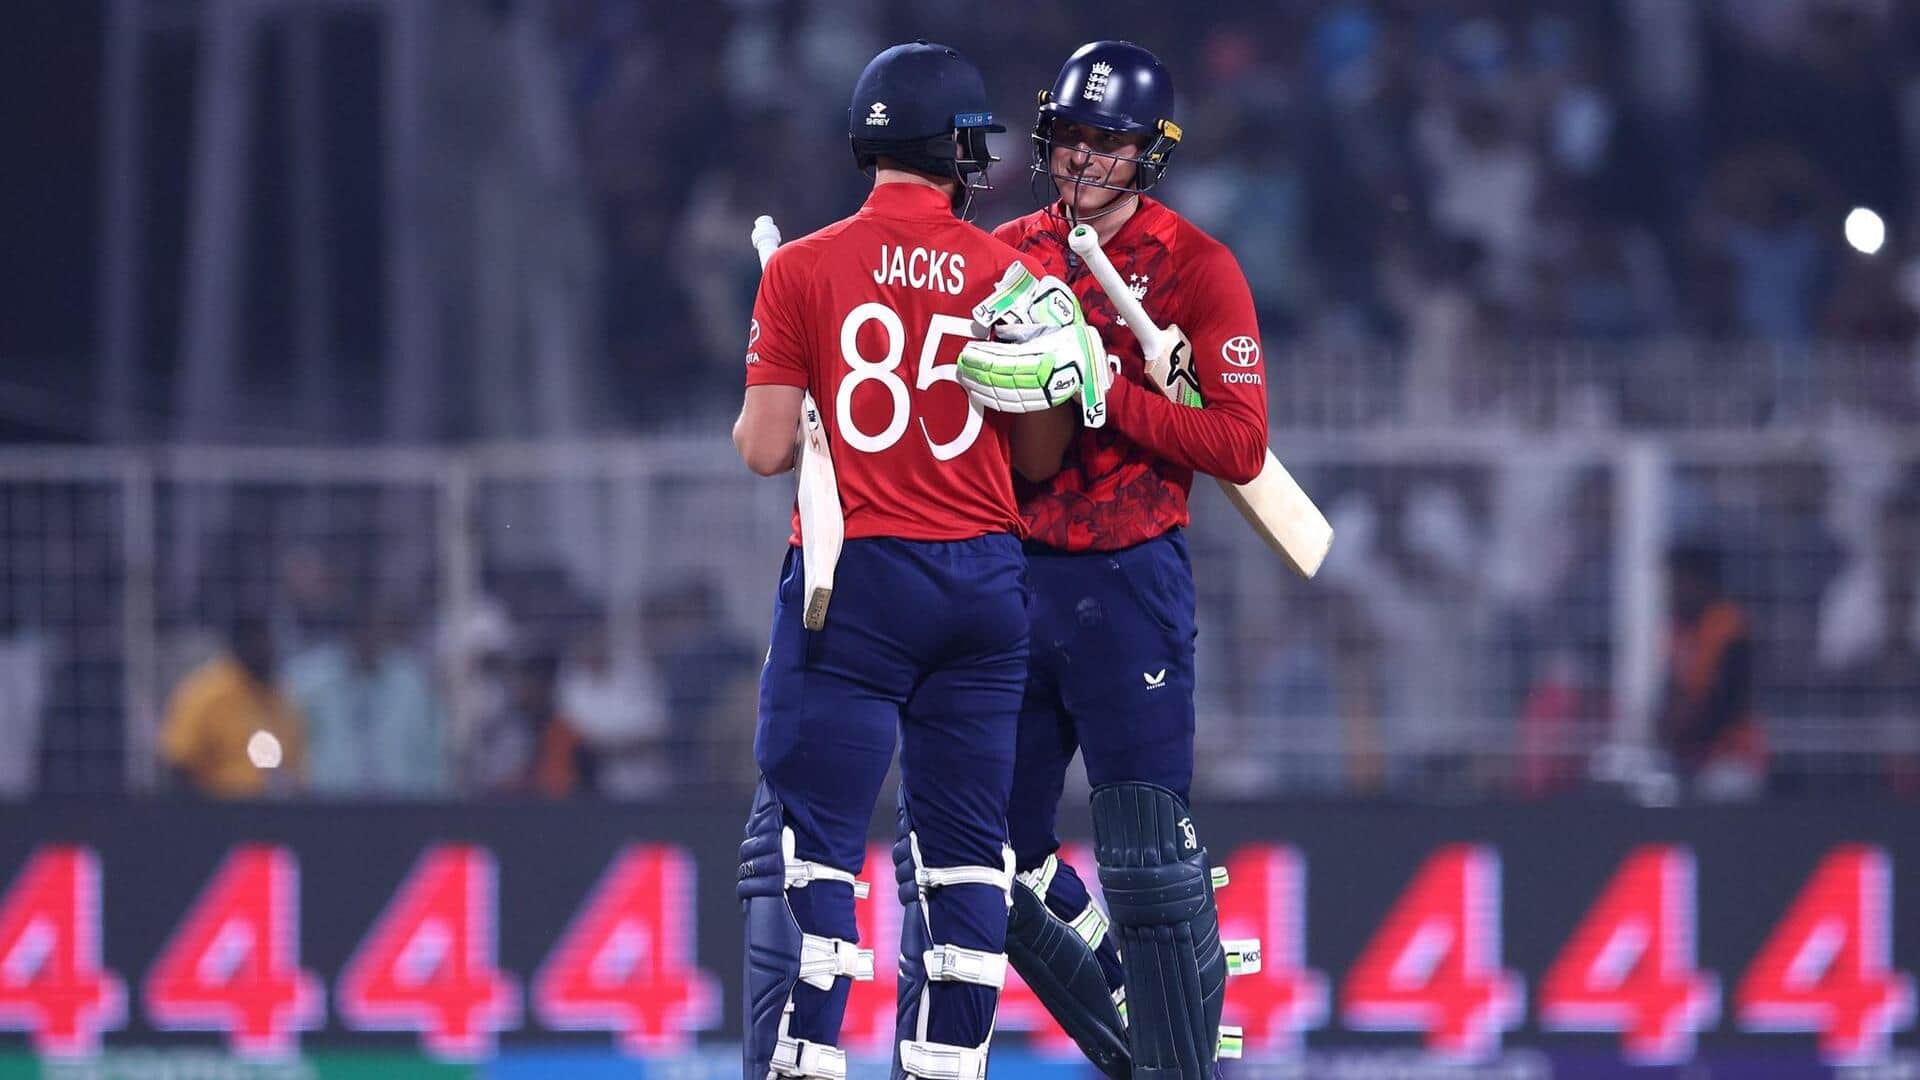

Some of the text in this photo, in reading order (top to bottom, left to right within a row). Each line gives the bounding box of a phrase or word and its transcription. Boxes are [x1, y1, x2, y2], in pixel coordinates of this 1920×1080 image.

[865, 117, 890, 126] SHREY
[872, 244, 966, 296] JACKS
[836, 302, 990, 462] 85
[144, 842, 326, 1062] 4
[336, 842, 525, 1062] 4
[532, 842, 723, 1064] 4
[1338, 842, 1528, 1064] 4
[1538, 842, 1724, 1066] 4
[1734, 842, 1918, 1066] 4
